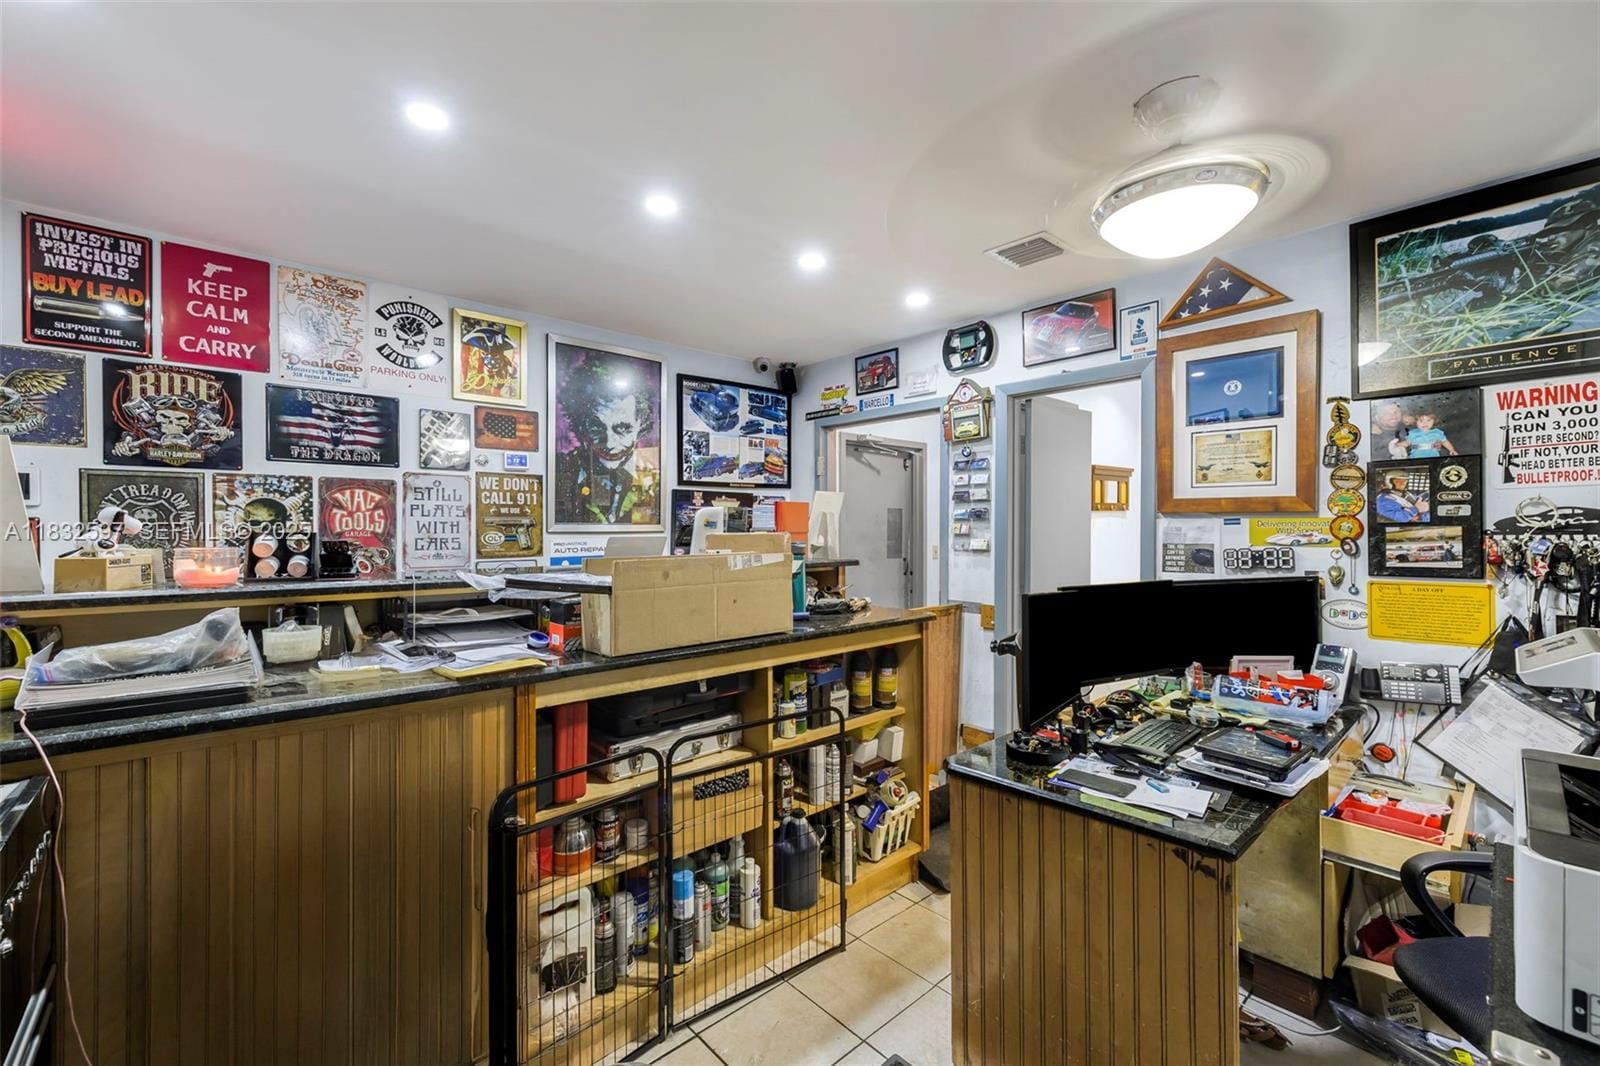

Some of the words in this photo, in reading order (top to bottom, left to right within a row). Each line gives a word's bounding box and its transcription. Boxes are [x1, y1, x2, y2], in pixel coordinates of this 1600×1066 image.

[35, 222, 114, 249] INVEST
[119, 239, 142, 256] IN
[38, 237, 139, 269] PRECIOUS
[44, 252, 134, 282] METALS.
[32, 272, 83, 296] BUY
[86, 281, 144, 307] LEAD
[187, 278, 248, 302] KEEP
[186, 300, 249, 325] CALM
[380, 302, 440, 327] PUNISHERS
[34, 327, 76, 340] SECOND
[78, 333, 140, 349] AMENDMENT.
[54, 321, 101, 334] SUPPORT
[103, 327, 122, 337] THE
[206, 324, 231, 336] AND
[179, 335, 256, 360] CARRY
[1453, 345, 1577, 368] PATIENCE
[370, 365, 416, 380] PARKING
[418, 372, 447, 384] ONLY!
[126, 369, 224, 404] RIDE
[1496, 380, 1598, 411] WARNING
[1511, 409, 1550, 421] CAN
[1557, 404, 1597, 417] YOU
[1513, 422, 1546, 433] RUN
[1552, 417, 1599, 431] 3,000
[1511, 435, 1533, 446] FEET
[1535, 434, 1553, 444] PER
[1556, 430, 1599, 443] SECOND?
[289, 445, 320, 459] THE
[322, 449, 381, 463] DRAGON
[1520, 448, 1530, 458] IF
[1534, 446, 1561, 457] NOT,
[1563, 444, 1599, 455] YOUR
[1521, 459, 1546, 470] HEAD
[1548, 457, 1580, 469] BETTER
[1588, 456, 1600, 467] BE
[113, 484, 174, 500] TREAD
[479, 476, 499, 490] WE
[503, 477, 540, 491] DON'T
[331, 488, 383, 511] MAC
[413, 486, 462, 502] STILL
[481, 491, 513, 505] CALL
[517, 492, 538, 505] 911
[410, 504, 466, 518] PLAYS
[332, 508, 385, 533] TOOLS
[416, 520, 460, 534] WITH
[1256, 520, 1297, 528] Delivering
[414, 537, 461, 551] CARS
